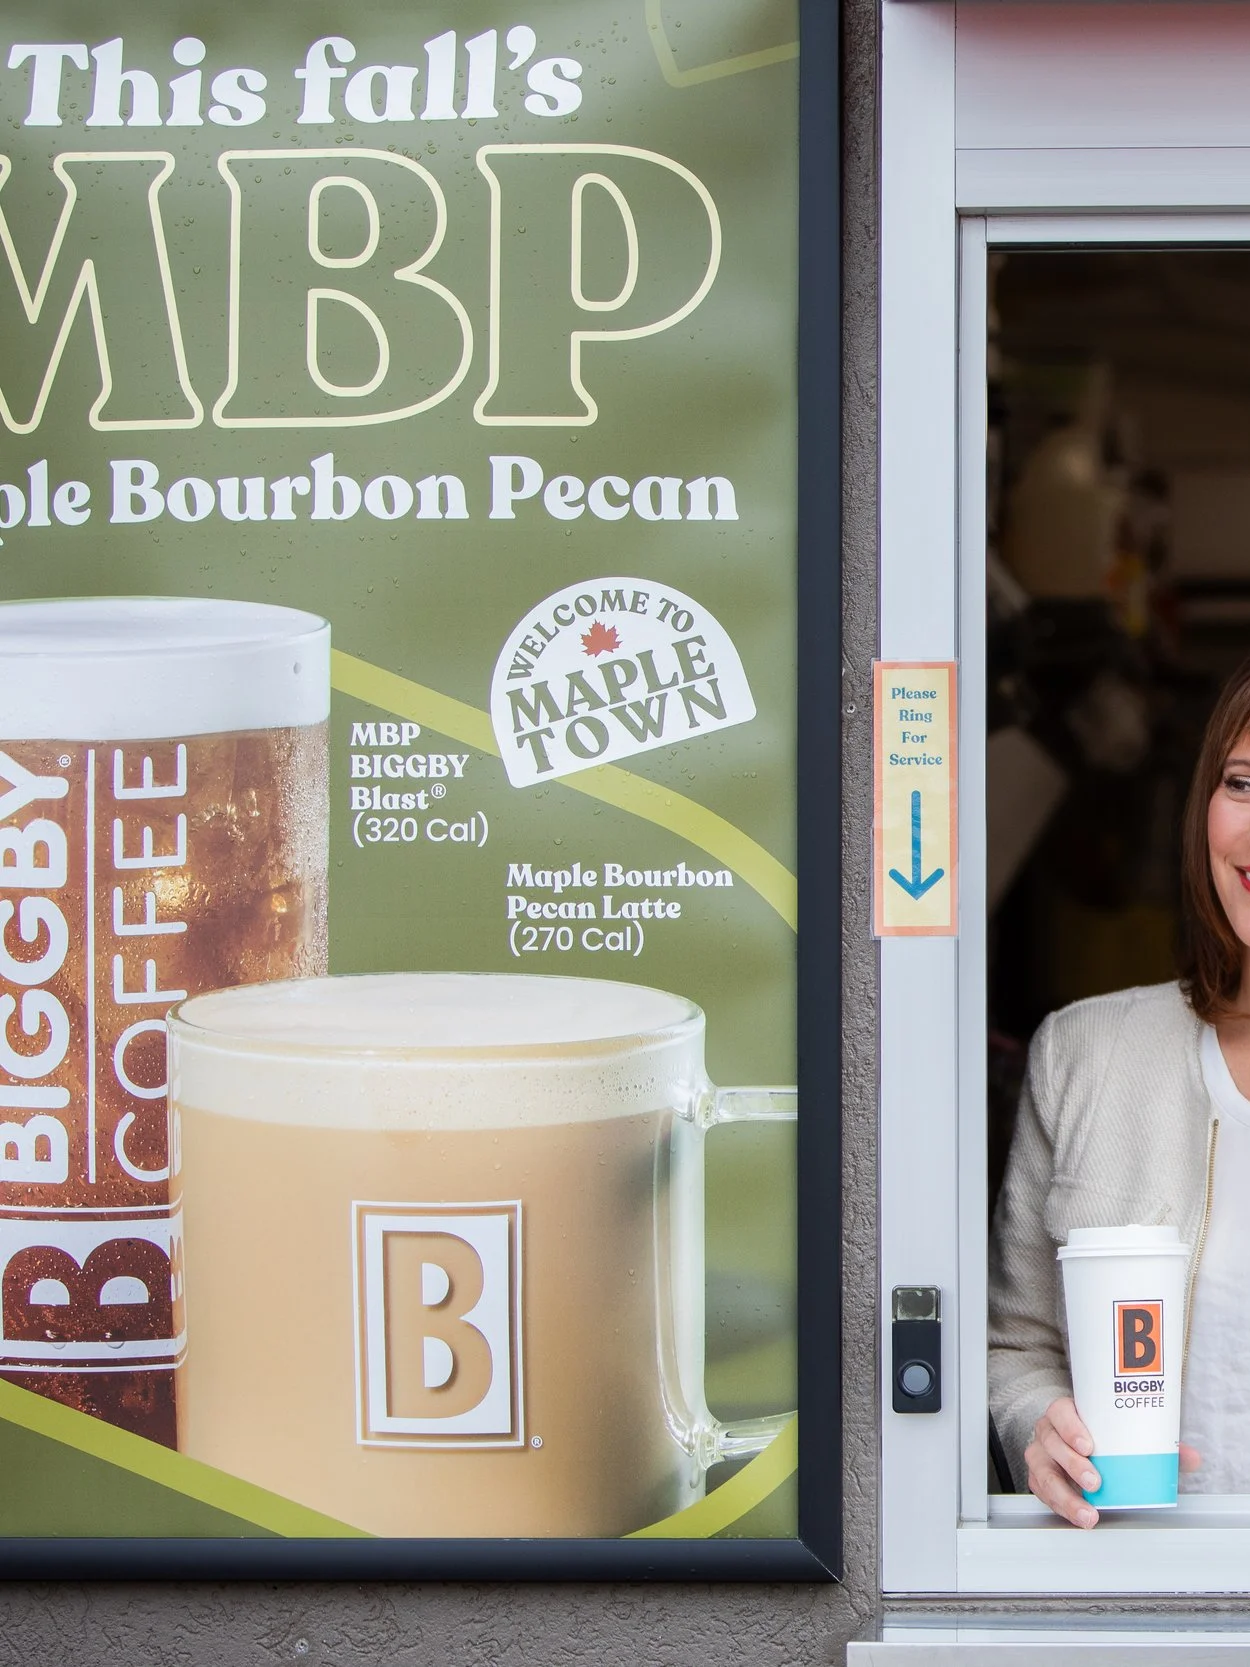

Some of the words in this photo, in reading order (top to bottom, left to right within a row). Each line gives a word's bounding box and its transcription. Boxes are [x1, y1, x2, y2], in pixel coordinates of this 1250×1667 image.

[8, 38, 268, 127] This
[294, 25, 584, 125] fall's
[0, 143, 722, 434] MBP
[109, 453, 469, 524] Bourbon
[489, 455, 739, 522] Pecan
[507, 588, 650, 681] WELCOME
[658, 597, 695, 633] TO
[505, 635, 716, 734] MAPLE
[891, 687, 937, 700] Please
[350, 722, 421, 747] MBP
[516, 677, 730, 775] TOWN
[899, 709, 932, 723] Ring
[901, 731, 927, 744] For
[350, 754, 470, 779] BIGGBY
[889, 753, 943, 766] Service
[352, 812, 418, 848] (320
[425, 811, 489, 848] Cal)
[506, 863, 597, 893] Maple
[603, 862, 734, 888] Bourbon
[507, 896, 597, 920] Pecan
[602, 896, 682, 920] Latte
[508, 921, 574, 957] (270
[580, 920, 645, 957] Cal)
[113, 742, 187, 1183] COFFEE
[2, 1237, 173, 1342] B
[383, 1230, 494, 1419] B
[1122, 1308, 1157, 1369] B
[1114, 1380, 1165, 1394] BIGGBY
[1114, 1397, 1165, 1410] COFFEE
